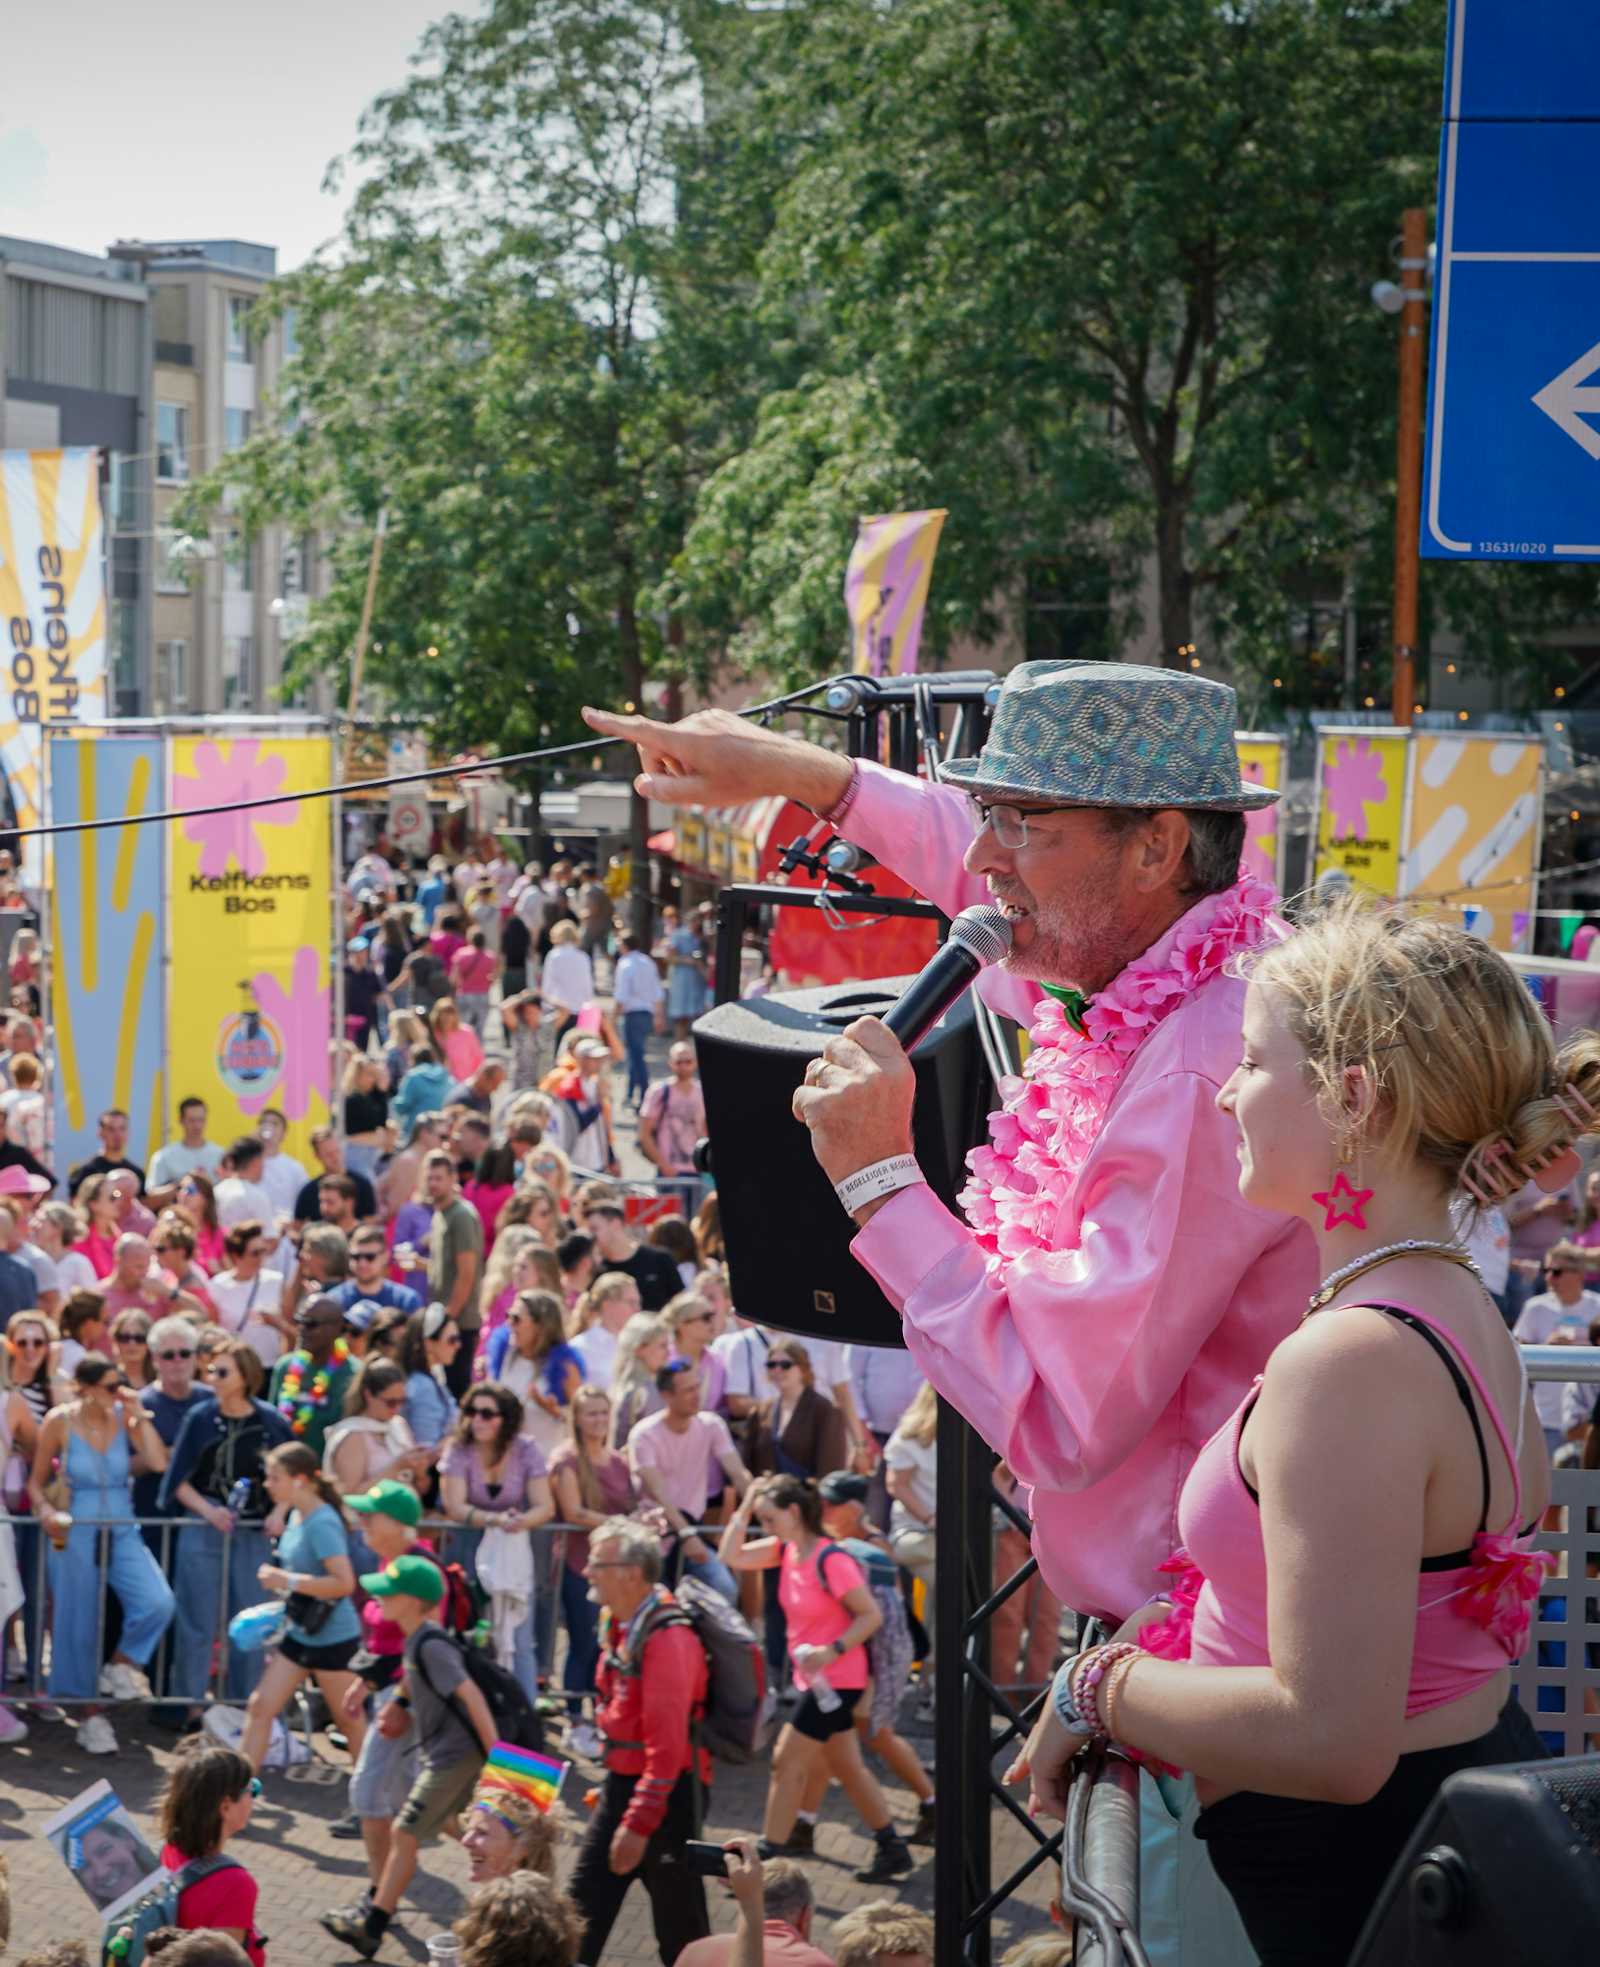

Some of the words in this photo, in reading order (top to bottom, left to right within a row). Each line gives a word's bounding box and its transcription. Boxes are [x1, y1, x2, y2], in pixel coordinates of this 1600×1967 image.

[1479, 542, 1546, 554] 13631/020
[189, 871, 311, 892] Kelfkens
[224, 896, 277, 914] Bos
